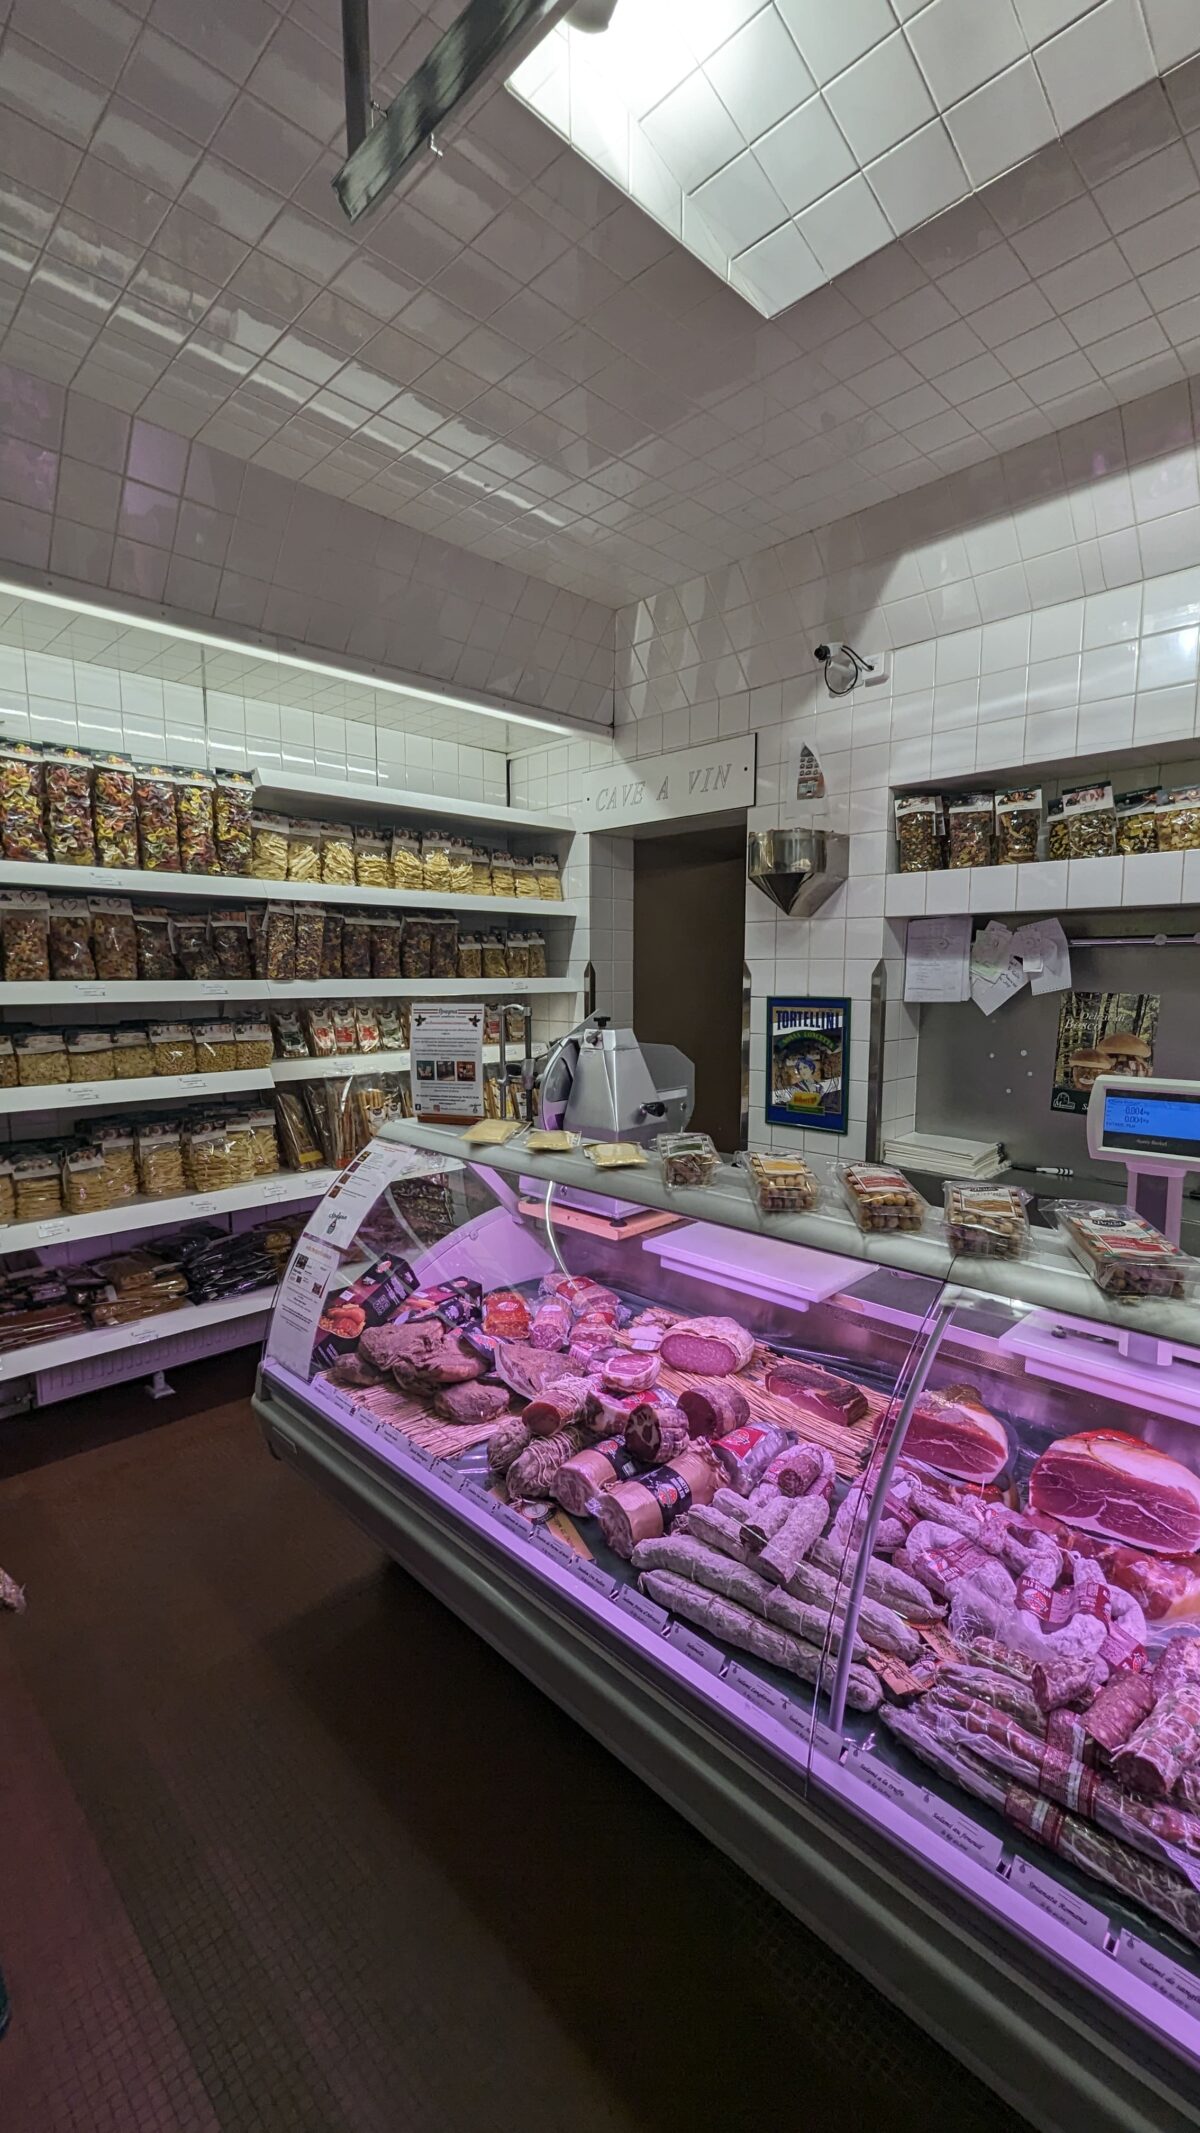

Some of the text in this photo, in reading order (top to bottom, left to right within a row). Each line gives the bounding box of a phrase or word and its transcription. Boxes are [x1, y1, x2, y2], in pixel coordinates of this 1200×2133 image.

[596, 764, 732, 811] CAVE A VIN
[776, 1011, 839, 1030] TORTELLINI
[1065, 1017, 1101, 1030] Bosco
